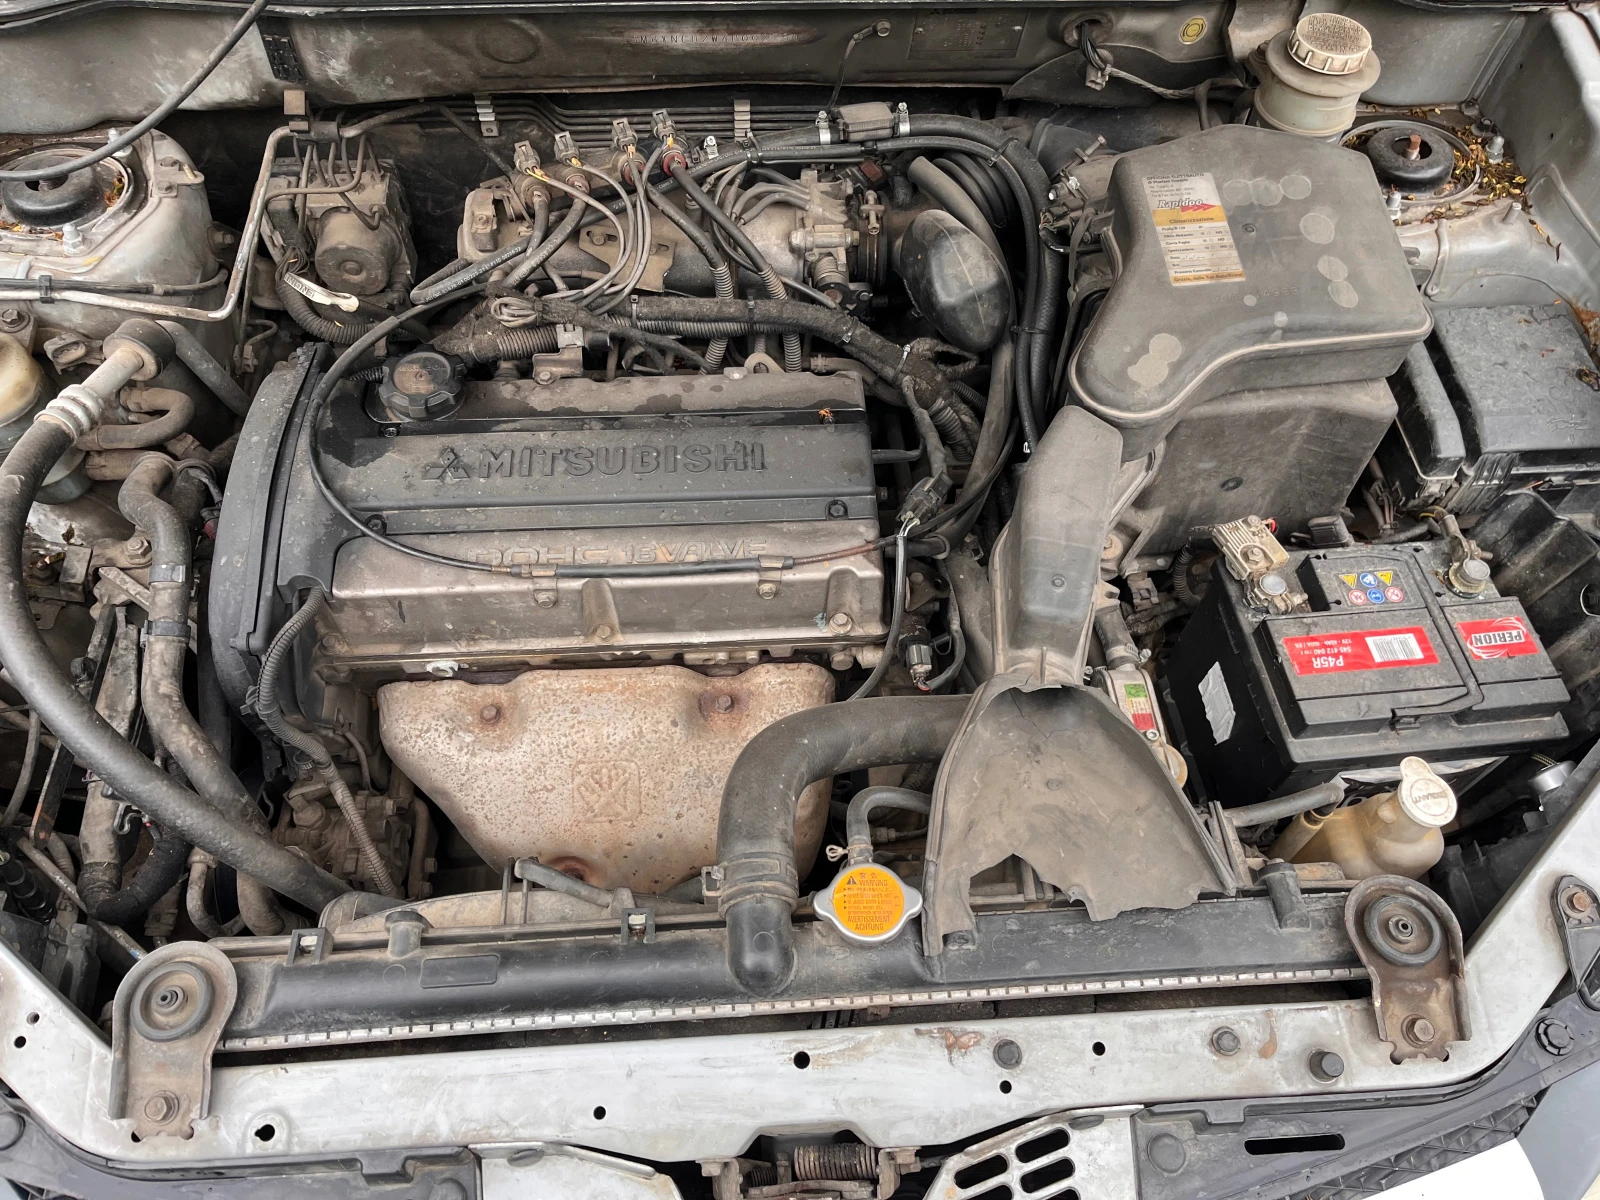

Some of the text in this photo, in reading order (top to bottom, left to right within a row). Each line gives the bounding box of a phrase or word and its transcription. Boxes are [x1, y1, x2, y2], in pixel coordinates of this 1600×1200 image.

[1157, 198, 1203, 209] Rapidoo
[478, 441, 768, 478] MITSUBISHI
[621, 543, 656, 564] 16
[656, 540, 767, 563] VALVE
[1472, 630, 1524, 646] PERION
[1312, 656, 1345, 669] P45R
[848, 915, 890, 923] AVERTISSEMENT
[855, 923, 884, 931] ACHTUNG
